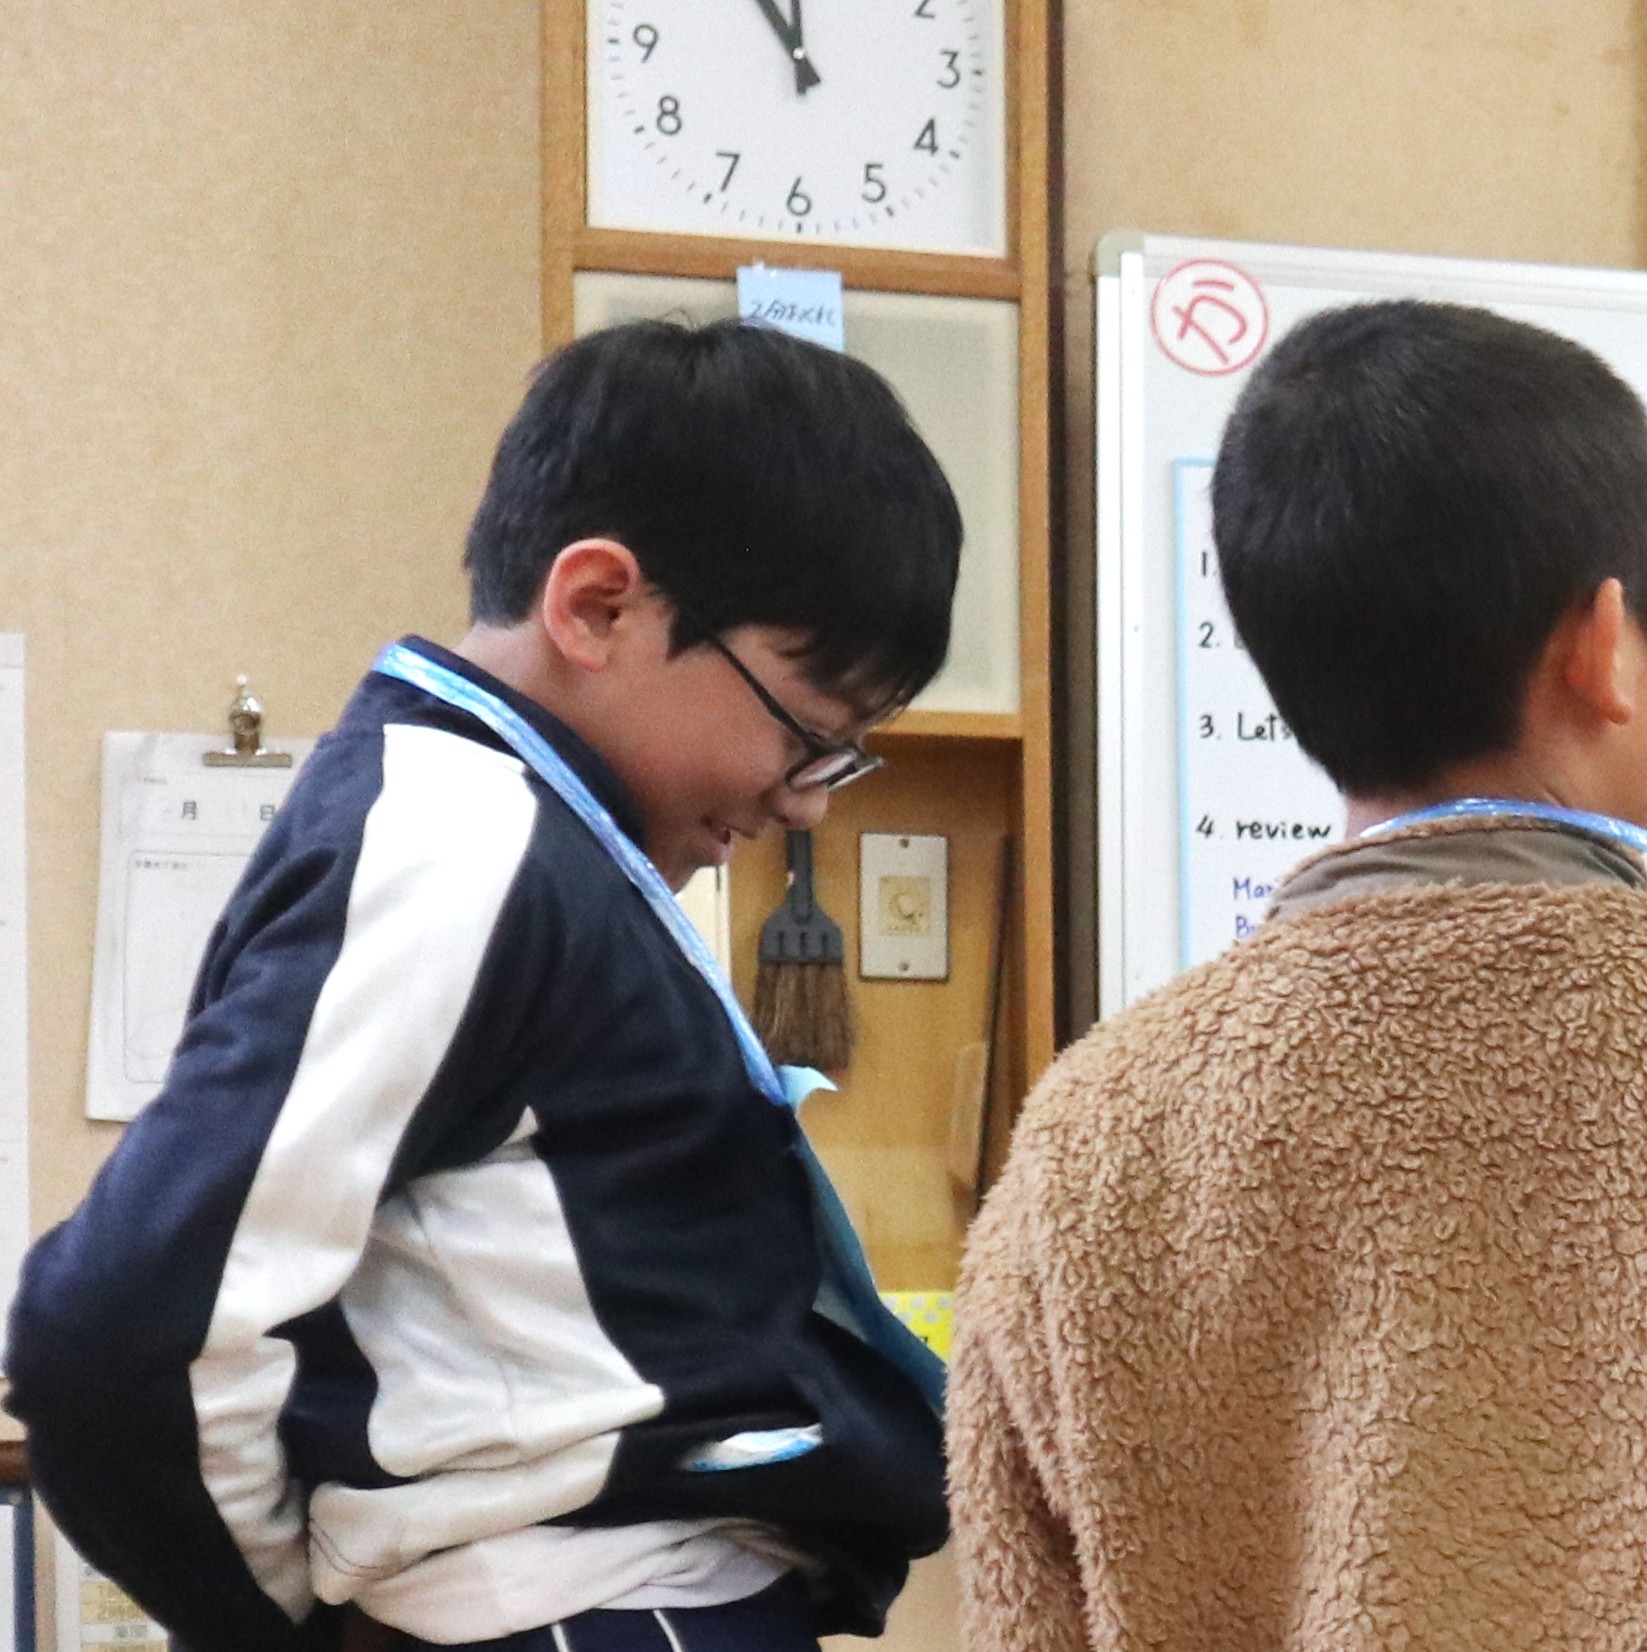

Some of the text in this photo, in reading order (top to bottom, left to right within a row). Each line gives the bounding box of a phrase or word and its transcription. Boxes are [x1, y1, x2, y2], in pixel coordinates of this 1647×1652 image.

[633, 24, 660, 63] 9
[936, 49, 961, 89] 3
[655, 95, 683, 136] 8
[913, 118, 939, 156] 4
[714, 151, 741, 192] 7
[862, 163, 887, 203] 5
[786, 177, 812, 216] 6
[181, 800, 198, 821] 月
[1236, 816, 1332, 841] review
